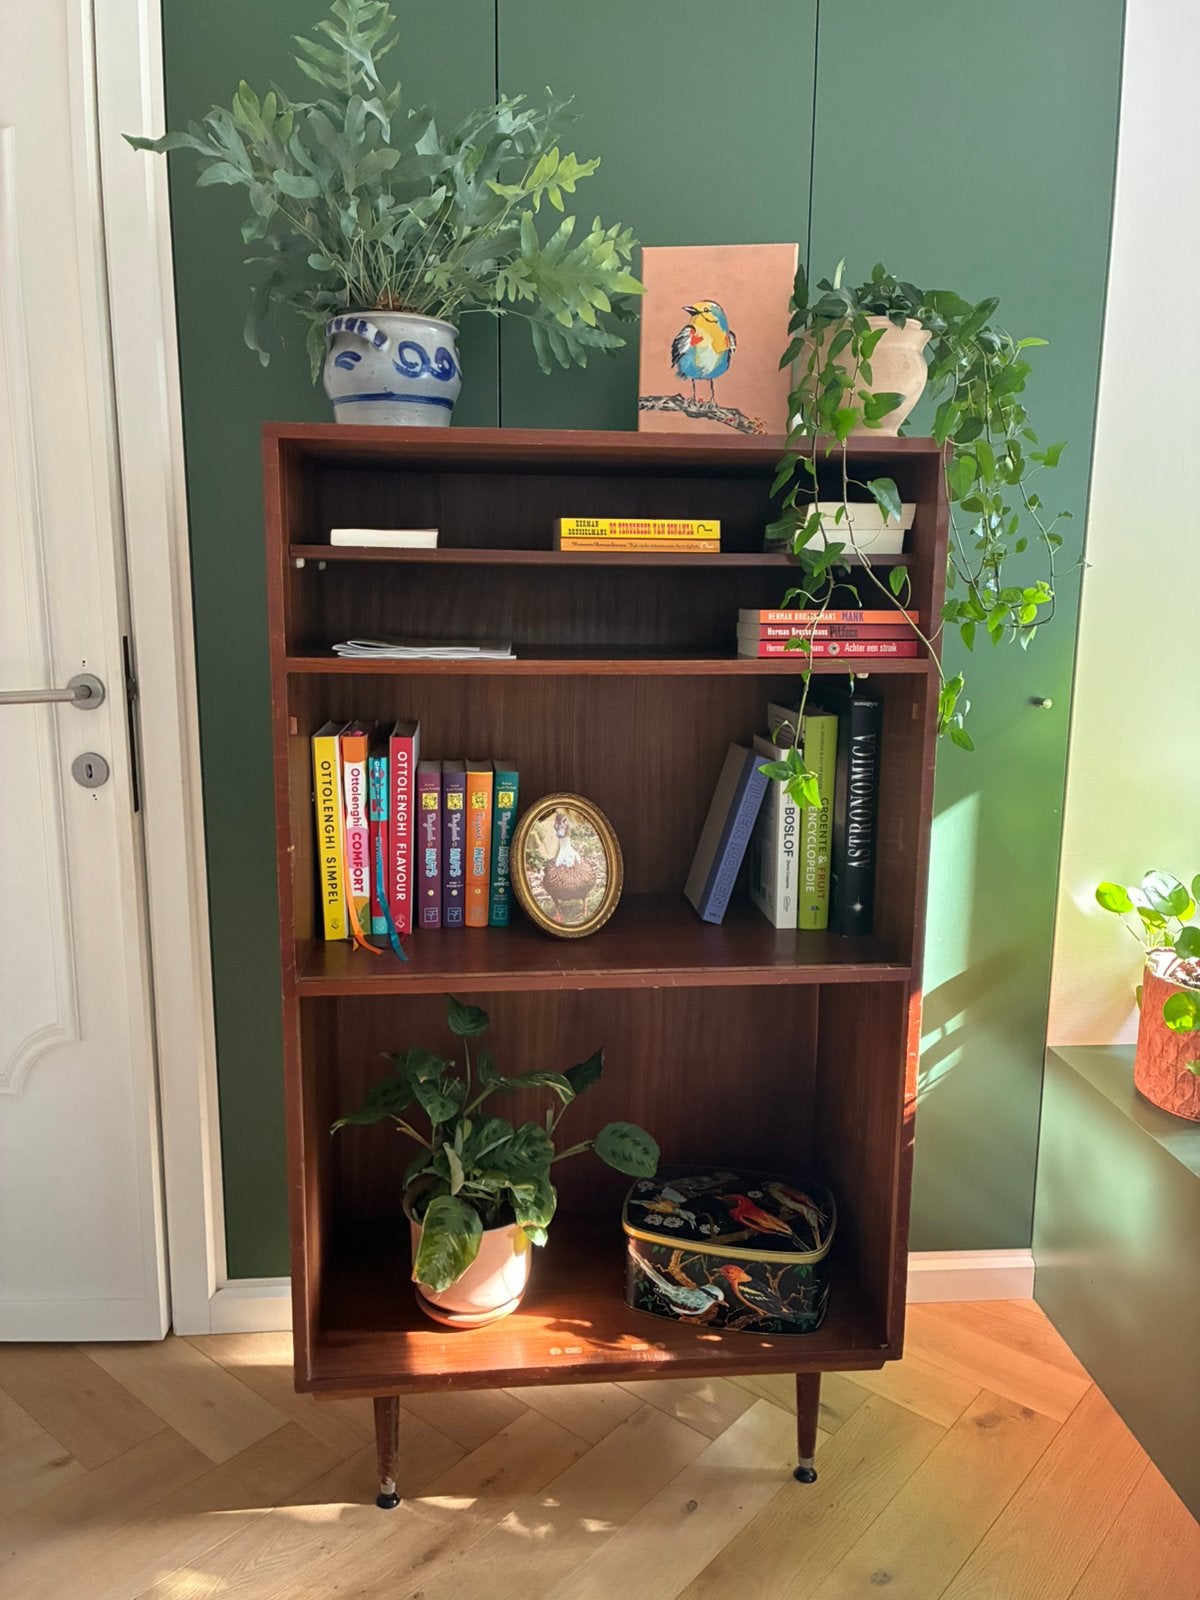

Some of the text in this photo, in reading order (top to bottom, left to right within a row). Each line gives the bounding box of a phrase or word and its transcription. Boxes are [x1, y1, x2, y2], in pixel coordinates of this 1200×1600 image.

[767, 627, 790, 636] Herman
[768, 612, 793, 621] HERMAN
[841, 611, 864, 622] MANK
[844, 642, 865, 652] Achter
[879, 642, 897, 653] struik
[396, 751, 408, 901] OTTOLENGHI FLAVOUR
[818, 797, 829, 852] GROENTE
[847, 733, 877, 869] ASTRONOMICA
[320, 760, 339, 905] OTTOLENGHI SIMPEL
[350, 767, 364, 893] Ottolenghi COMFORT
[783, 807, 796, 858] BOSLOF
[805, 806, 818, 893] ENCYCLOPEDIE
[473, 847, 486, 876] MUTS
[710, 843, 744, 908] KOKEN
[817, 867, 827, 900] FRUIT
[818, 856, 828, 865] &
